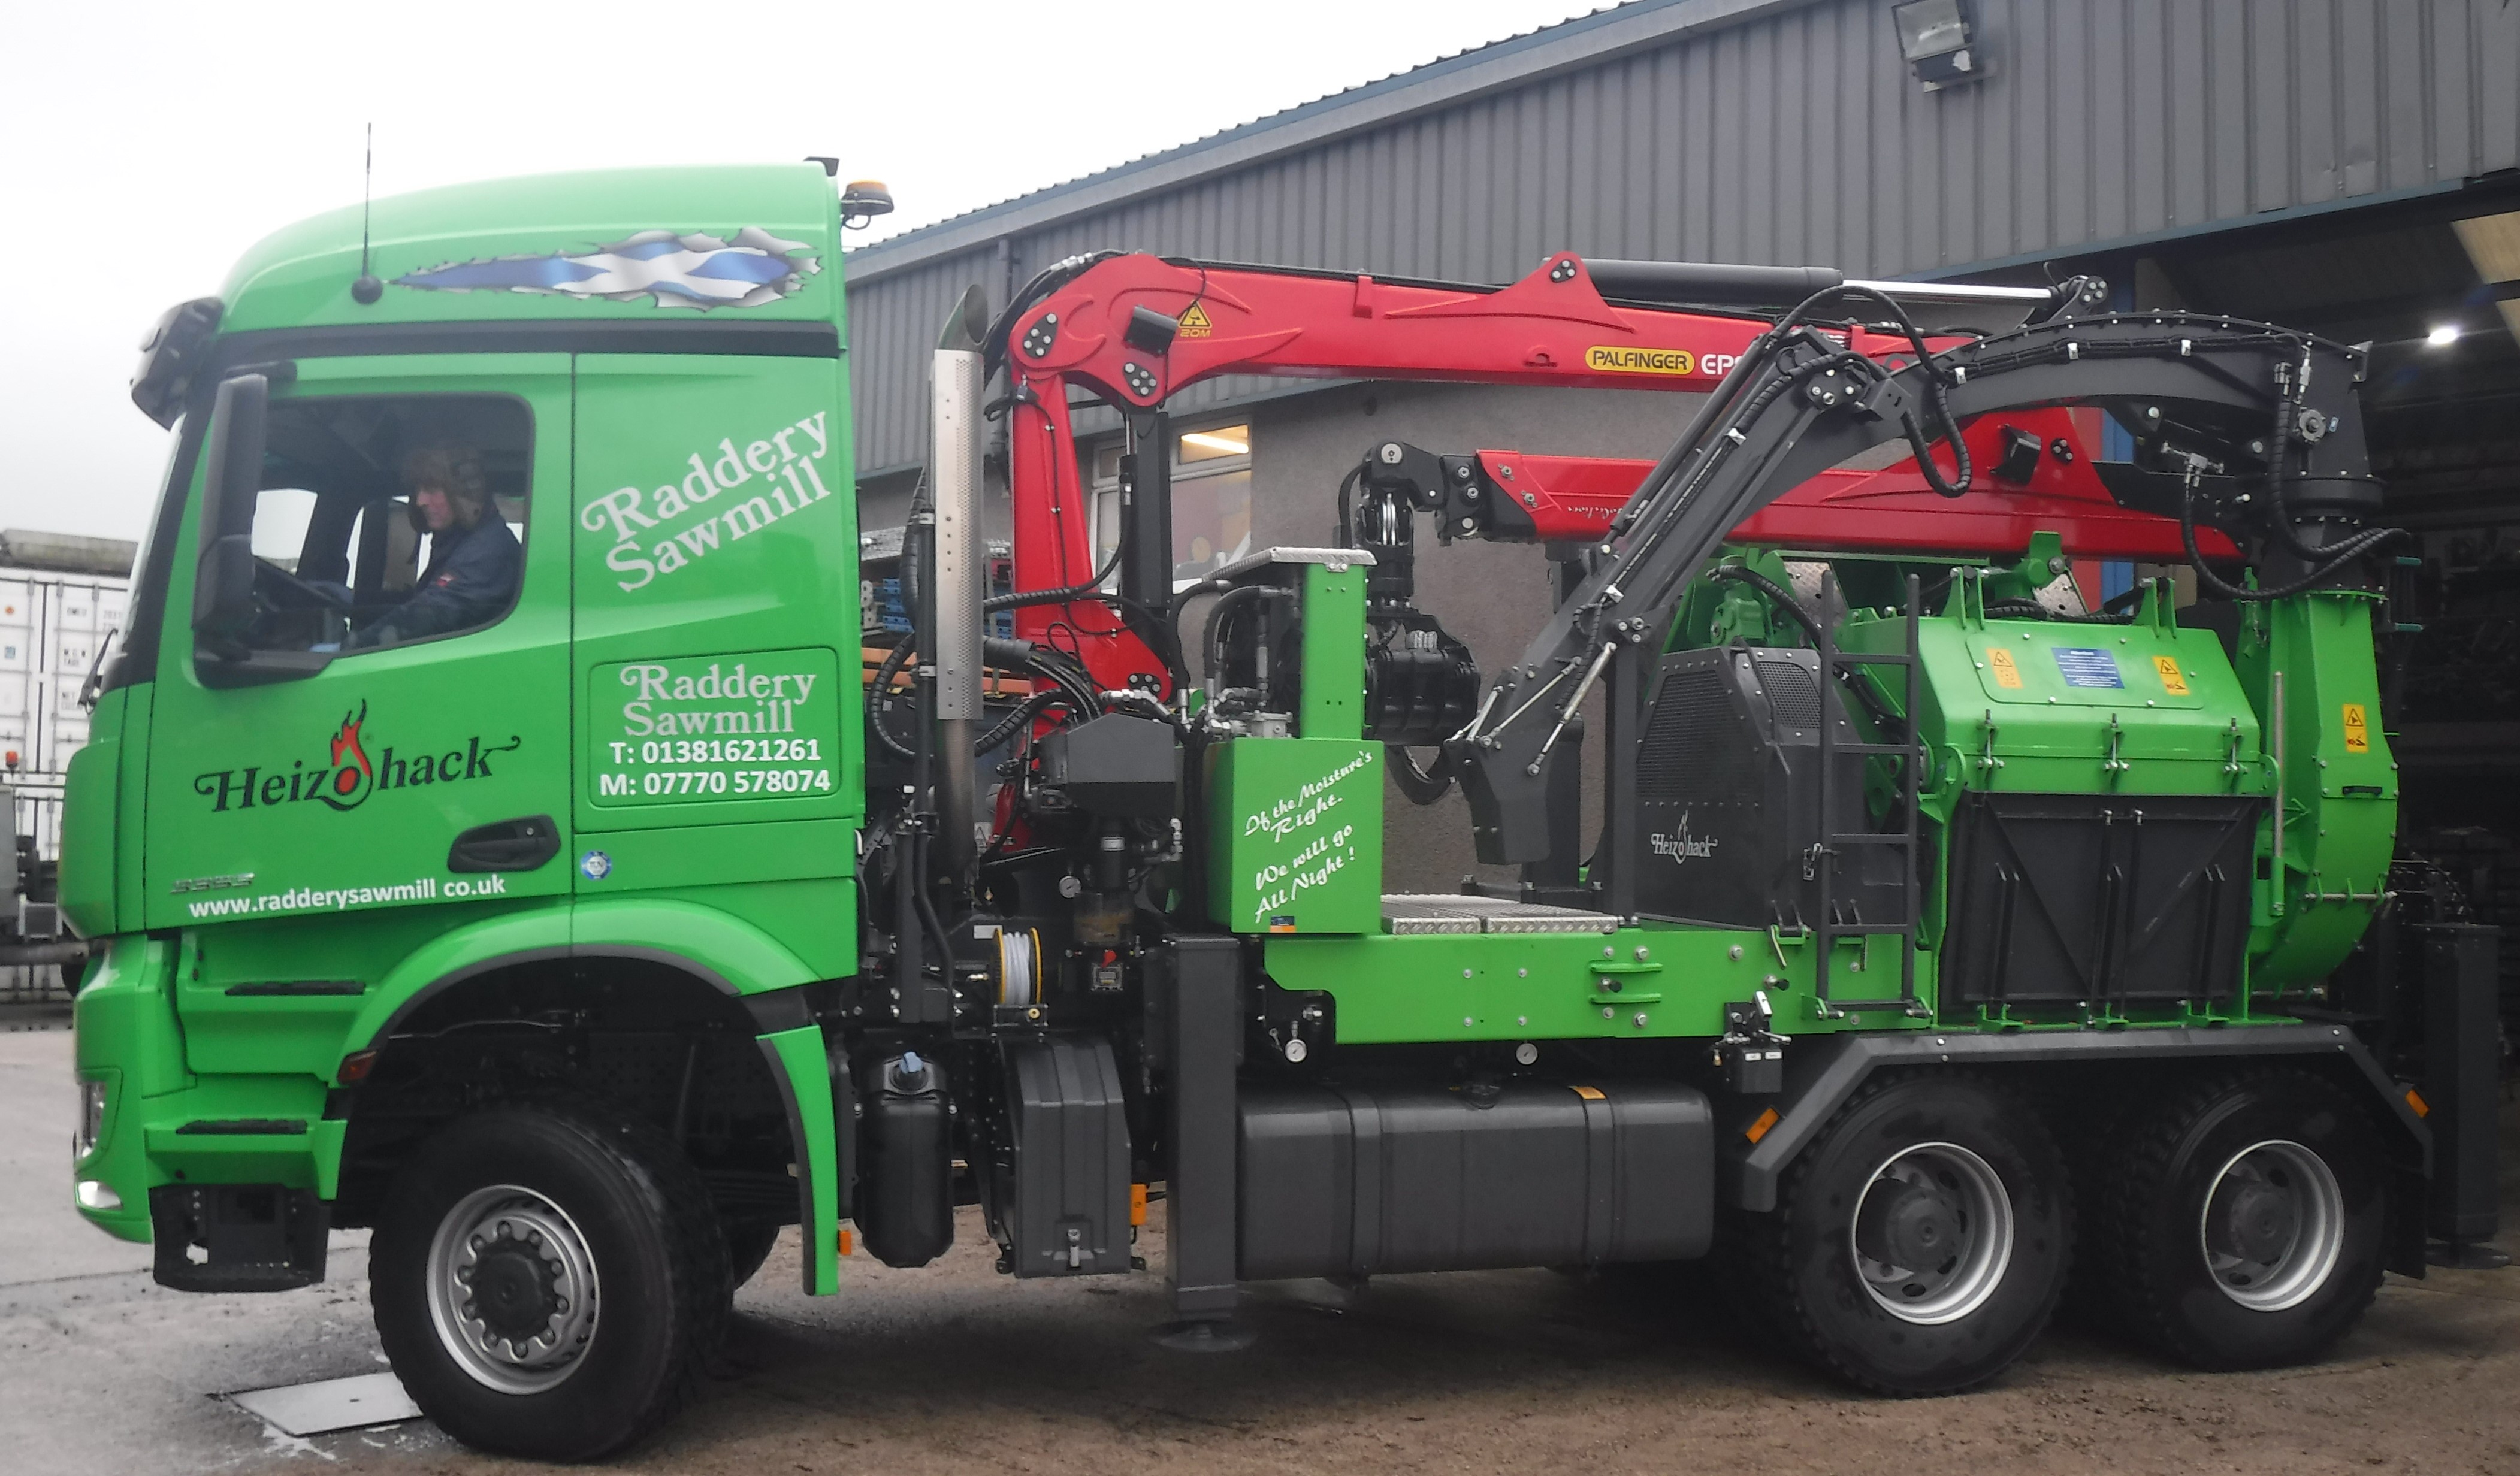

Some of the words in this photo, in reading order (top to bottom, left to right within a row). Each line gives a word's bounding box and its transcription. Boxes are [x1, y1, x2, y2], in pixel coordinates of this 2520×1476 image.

[1180, 329, 1211, 337] 20M
[1593, 350, 1688, 370] PALFINGER
[1701, 353, 1743, 375] EP
[580, 410, 827, 543] Raddery
[605, 455, 831, 593] Sawmill
[620, 663, 817, 705] Raddery
[623, 698, 794, 737] Sawmill
[609, 742, 635, 764] T:
[641, 739, 821, 764] 01381621261
[600, 774, 636, 796] M:
[643, 771, 727, 796] 07770
[733, 769, 832, 793] 578074
[1272, 799, 1297, 819] the
[1298, 750, 1373, 808] Moisture's
[1270, 794, 1344, 843] Right.
[1255, 864, 1289, 891] We
[1292, 836, 1329, 869] will
[1332, 824, 1353, 848] go
[1651, 833, 1718, 864] Heizohack
[443, 873, 506, 898] co.uk
[1255, 888, 1289, 924] All
[1291, 855, 1346, 901] Night
